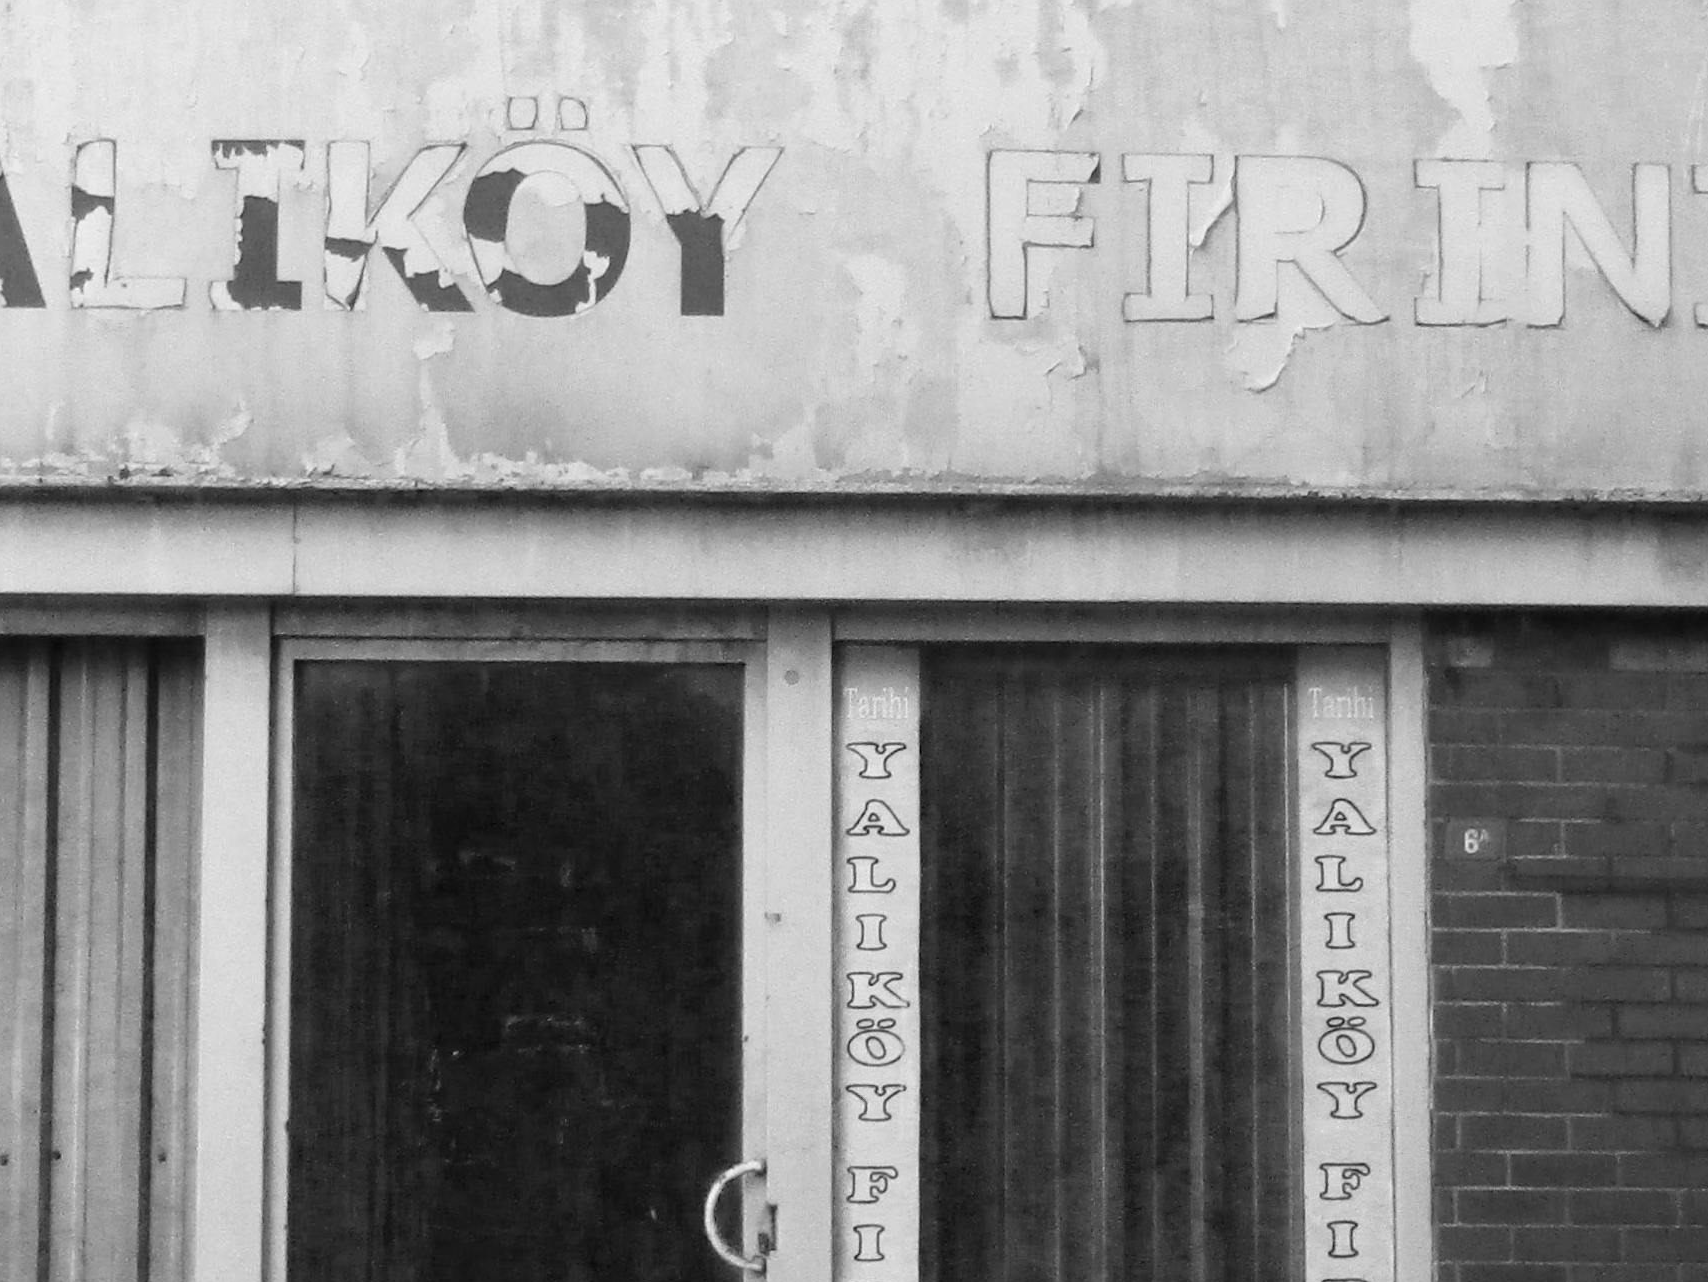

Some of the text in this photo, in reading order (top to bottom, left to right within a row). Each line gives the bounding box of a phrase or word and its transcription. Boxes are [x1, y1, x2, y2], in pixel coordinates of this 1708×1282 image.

[843, 685, 909, 719] Tarihi
[1307, 685, 1374, 720] Tarihi
[845, 741, 911, 1122] YALIKÖY
[1310, 741, 1380, 1120] YALIKÖY
